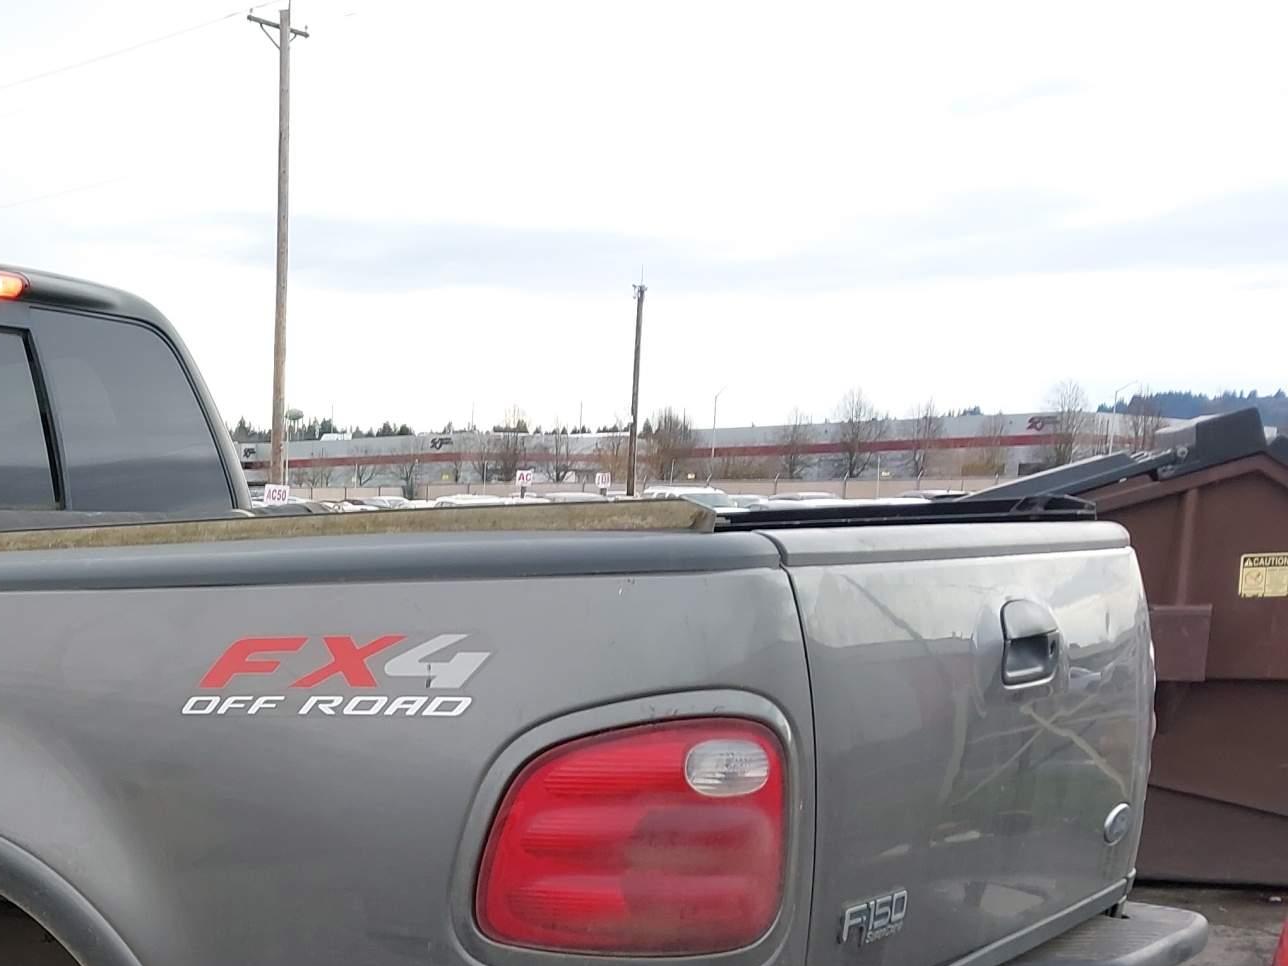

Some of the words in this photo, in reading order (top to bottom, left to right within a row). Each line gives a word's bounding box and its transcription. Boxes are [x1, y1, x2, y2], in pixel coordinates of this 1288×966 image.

[198, 633, 492, 689] FX4
[181, 695, 286, 715] OFF
[298, 695, 472, 716] ROAD
[841, 889, 908, 943] F150
